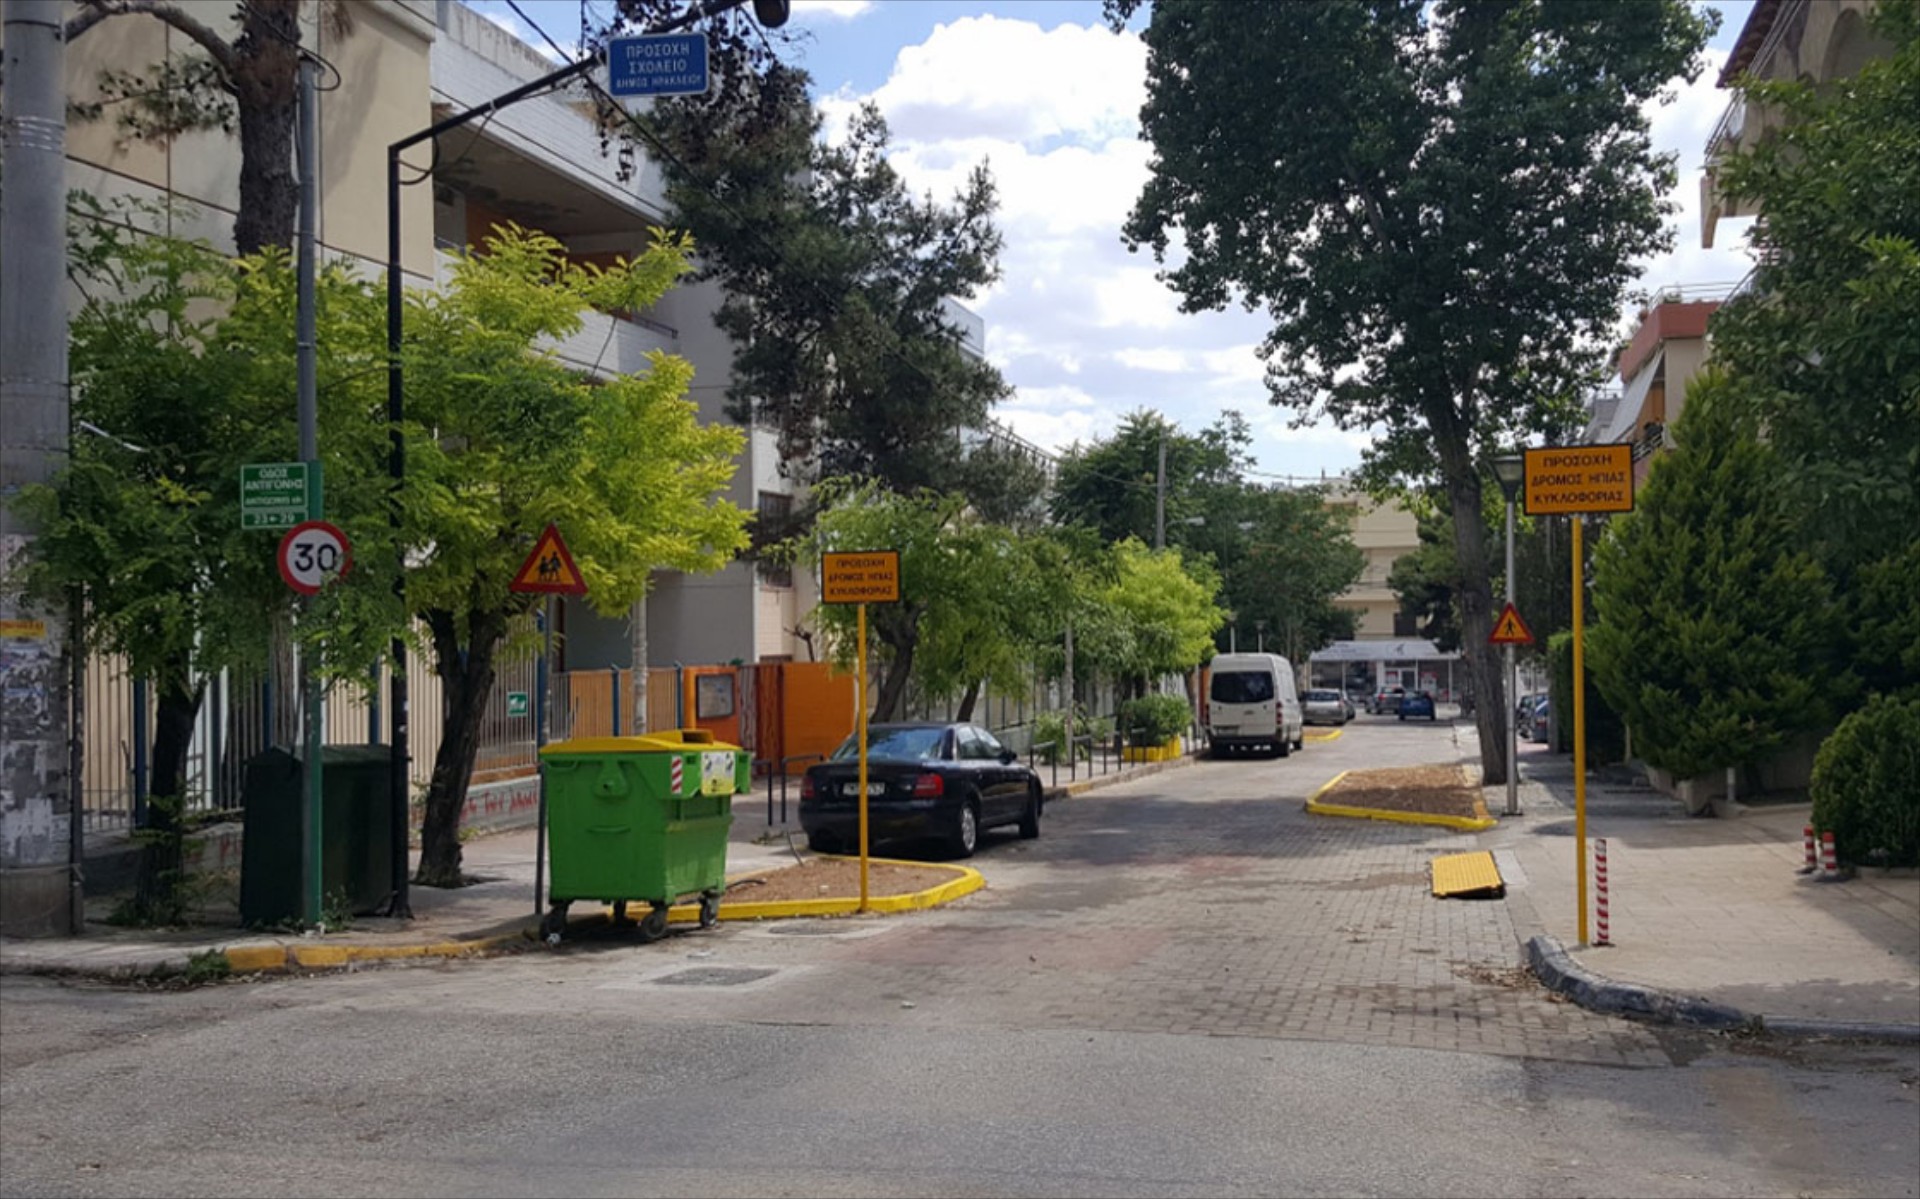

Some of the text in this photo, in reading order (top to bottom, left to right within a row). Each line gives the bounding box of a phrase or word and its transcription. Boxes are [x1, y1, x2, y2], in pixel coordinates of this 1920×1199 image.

[626, 43, 690, 58] ΠΡΟΣΟΧΗ
[629, 59, 687, 74] ΣΧΟΛΕΙΟ
[1543, 454, 1612, 467] ΠΡΟΣΟΧΗ
[1532, 471, 1625, 487] ΔΡΟΜΟΣ ΗΠΙΑΣ
[1534, 491, 1624, 504] ΚΥΚΛΟΦΟΡΙΑΣ
[295, 543, 337, 572] 30
